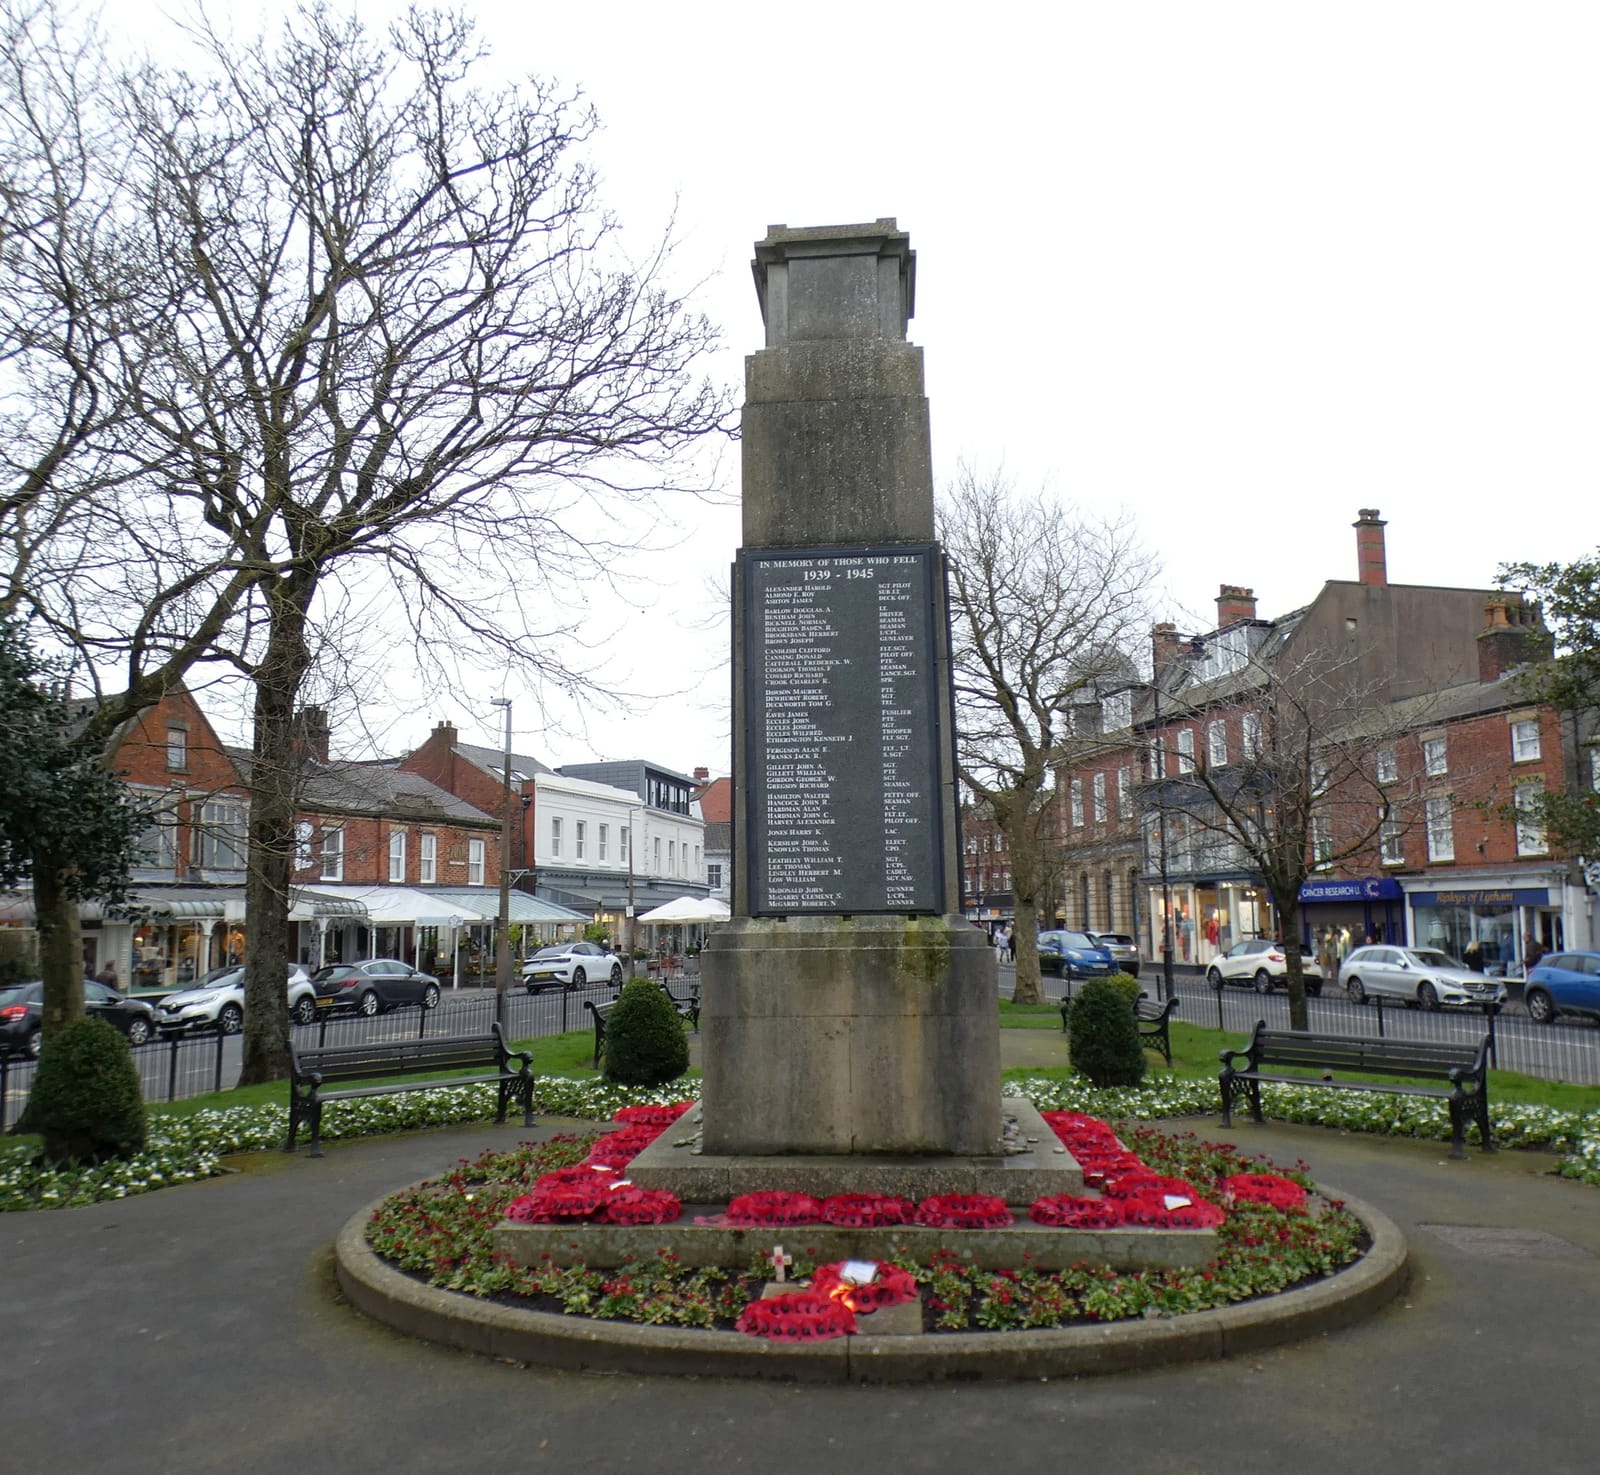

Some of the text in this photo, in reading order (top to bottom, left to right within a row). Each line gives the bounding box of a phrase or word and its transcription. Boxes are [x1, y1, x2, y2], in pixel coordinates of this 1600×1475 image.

[773, 560, 814, 568] MEMORY
[804, 570, 831, 580] 1939
[846, 569, 874, 579] 1945
[1302, 888, 1323, 897] CANCER
[1325, 886, 1354, 896] RESEARCH
[1468, 892, 1478, 904] of
[1479, 891, 1513, 904] Lytham
